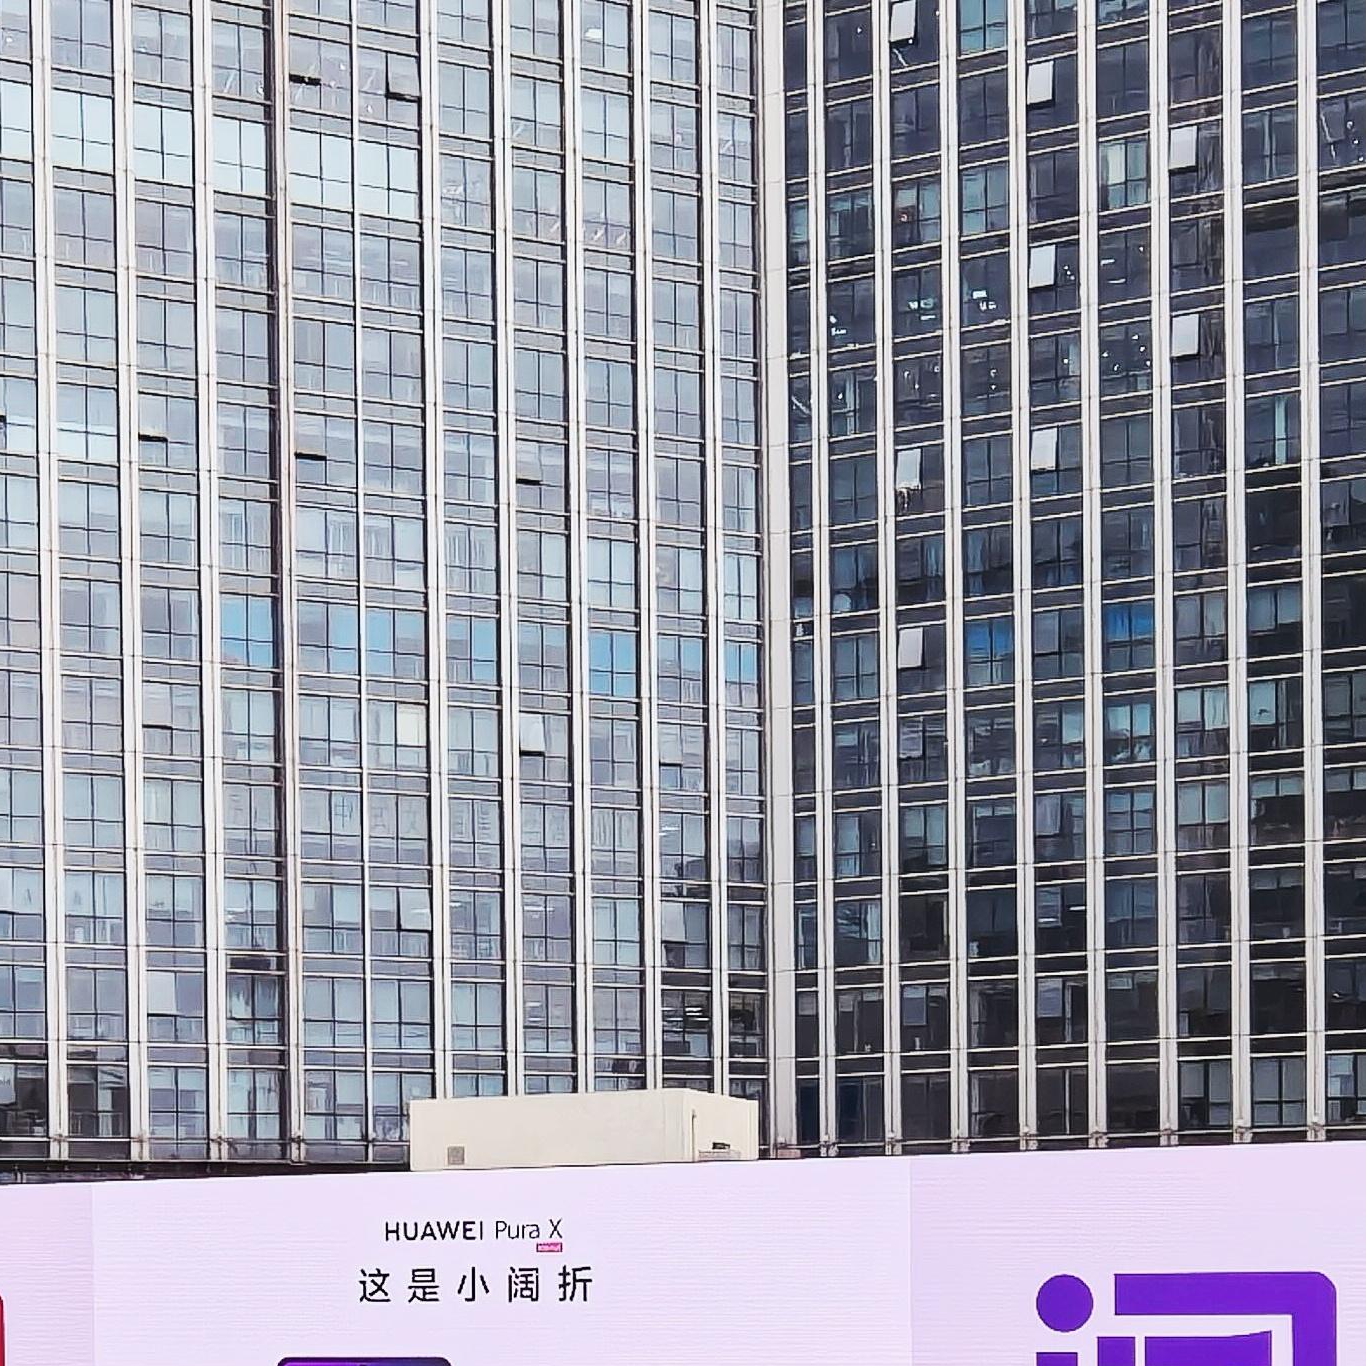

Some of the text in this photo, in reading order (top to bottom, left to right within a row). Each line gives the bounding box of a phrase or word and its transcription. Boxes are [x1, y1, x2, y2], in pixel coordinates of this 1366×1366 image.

[385, 1218, 563, 1241] HUAWEI Pura X
[359, 1265, 592, 1303] 这是小阔折
